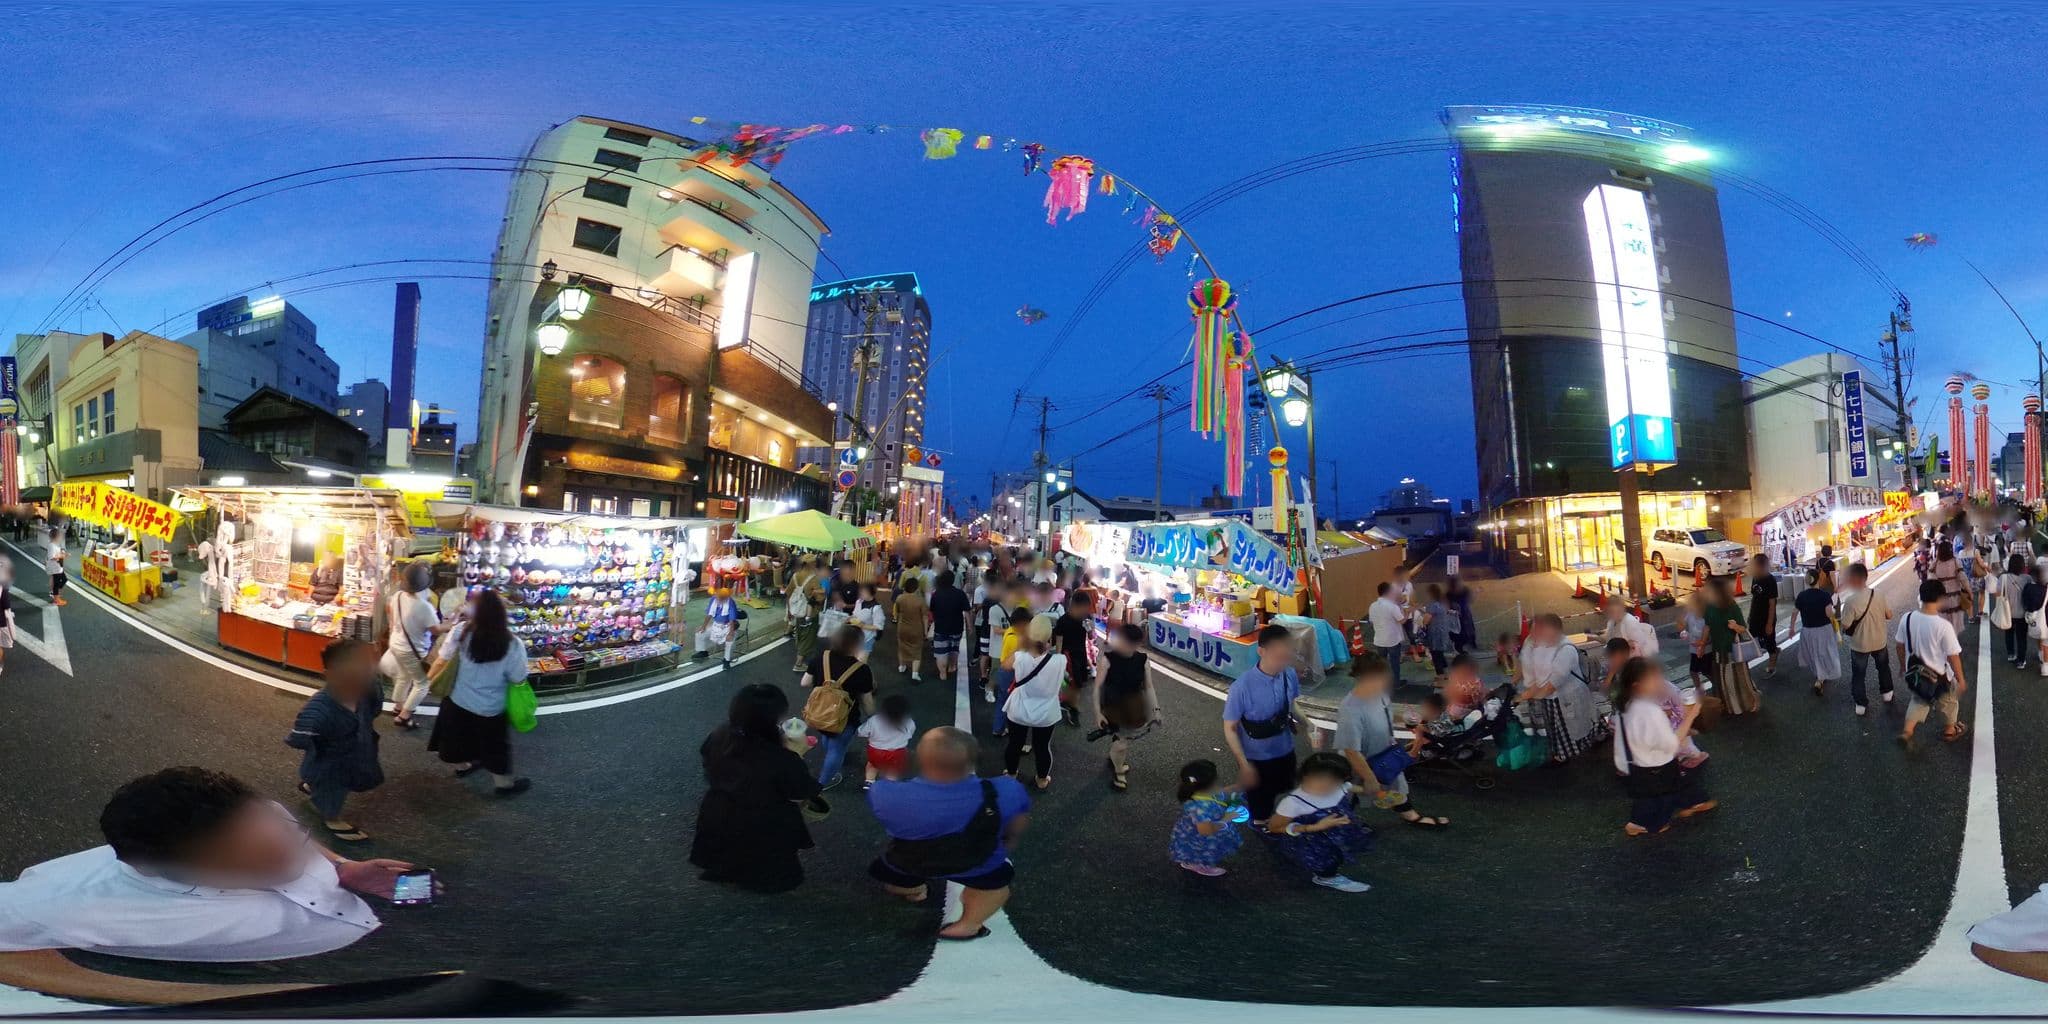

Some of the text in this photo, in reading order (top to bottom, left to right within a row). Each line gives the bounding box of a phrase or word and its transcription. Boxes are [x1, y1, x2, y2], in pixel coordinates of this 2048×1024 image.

[1616, 424, 1625, 440] P
[1646, 419, 1663, 440] P
[1847, 395, 1865, 470] 七十七銀行
[1850, 488, 1879, 507] はしまき
[1792, 499, 1827, 527] はしまき
